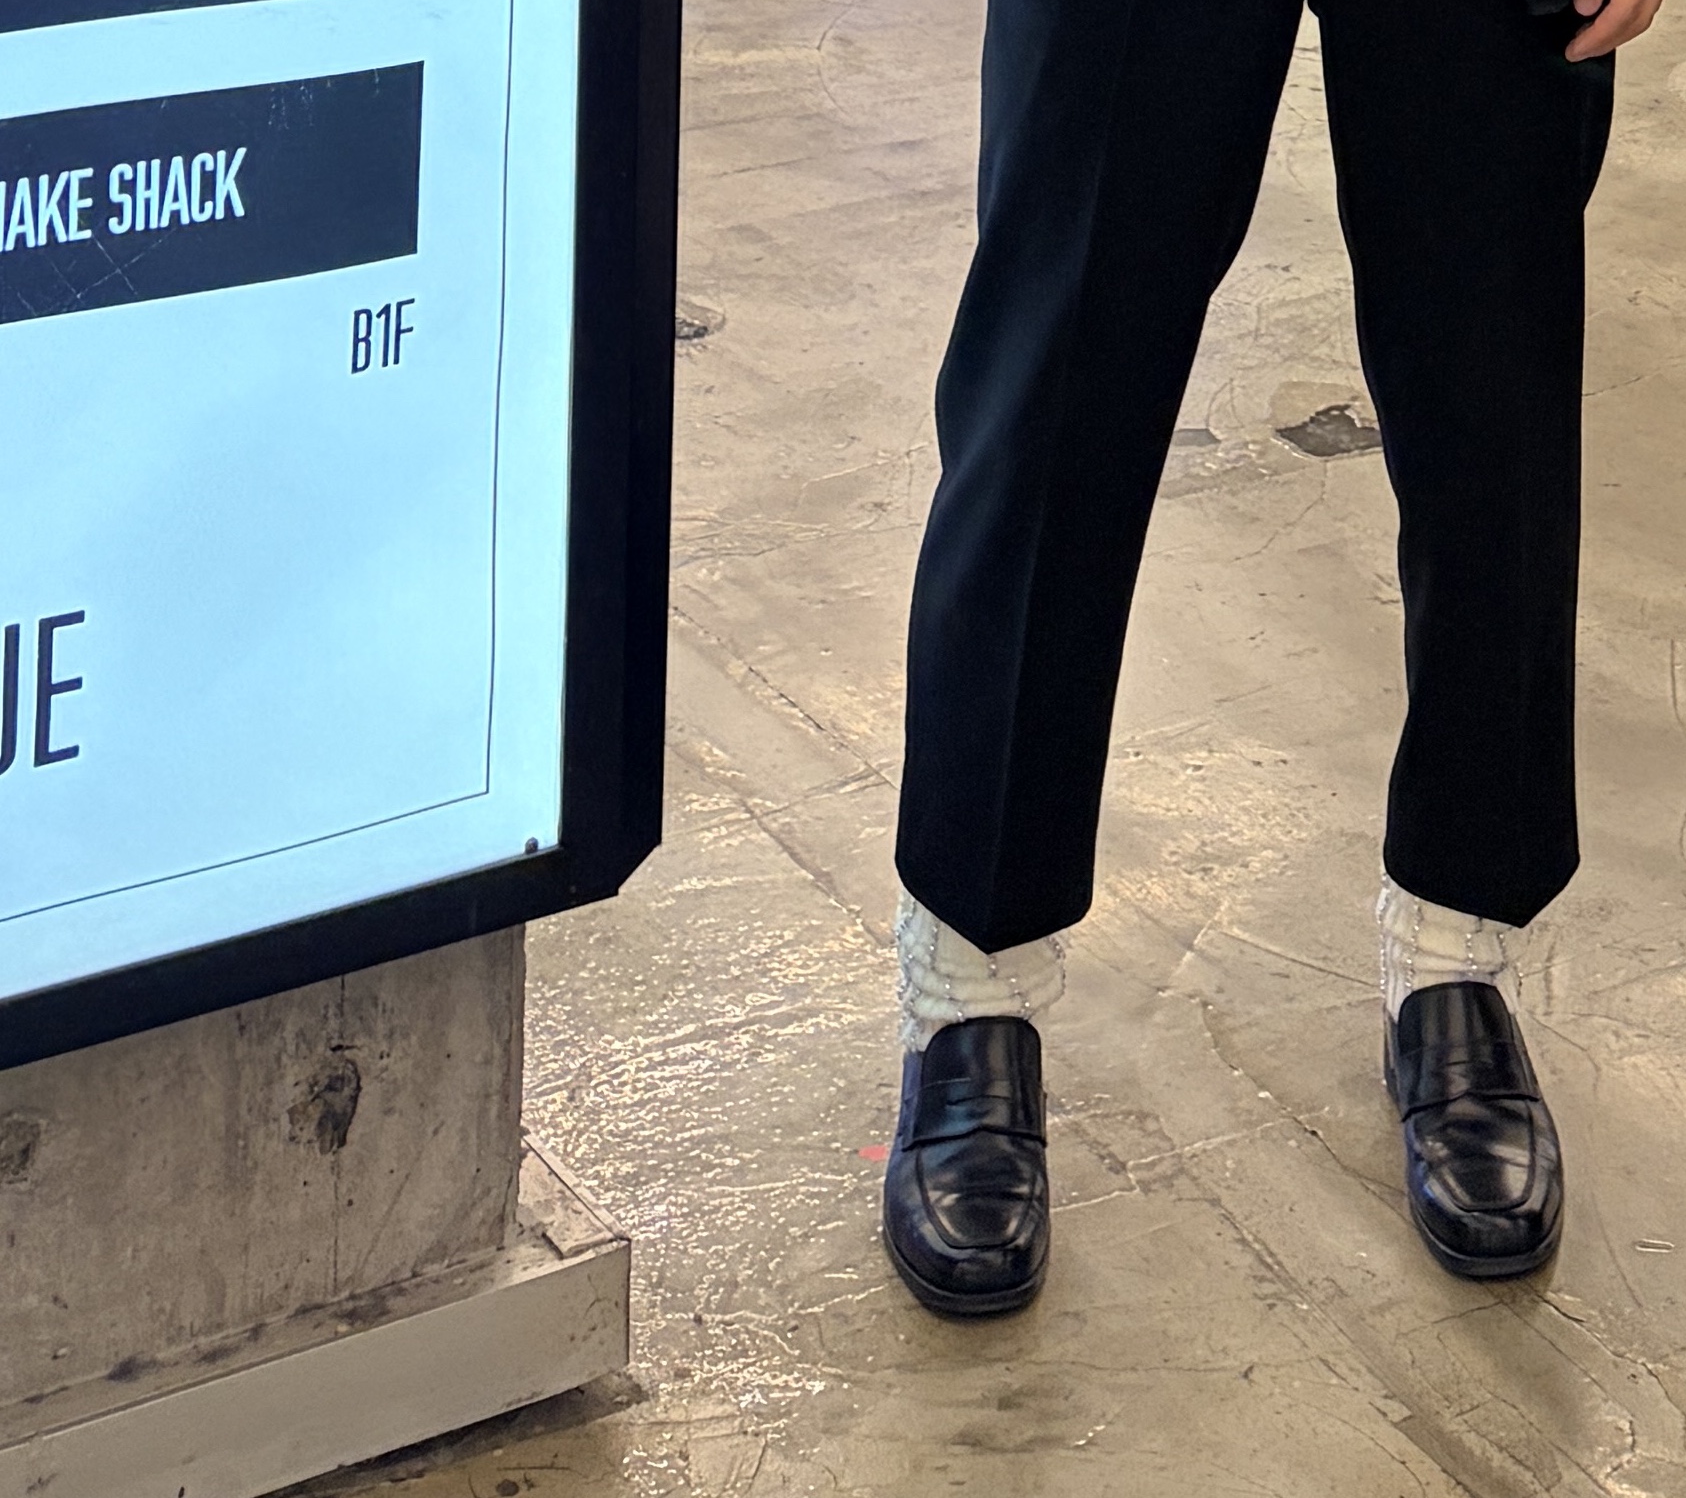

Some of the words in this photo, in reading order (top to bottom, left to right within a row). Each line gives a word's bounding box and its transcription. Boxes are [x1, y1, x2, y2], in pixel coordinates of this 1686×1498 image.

[0, 167, 94, 251] AKE
[108, 147, 247, 235] SHACK
[351, 298, 416, 375] B1F
